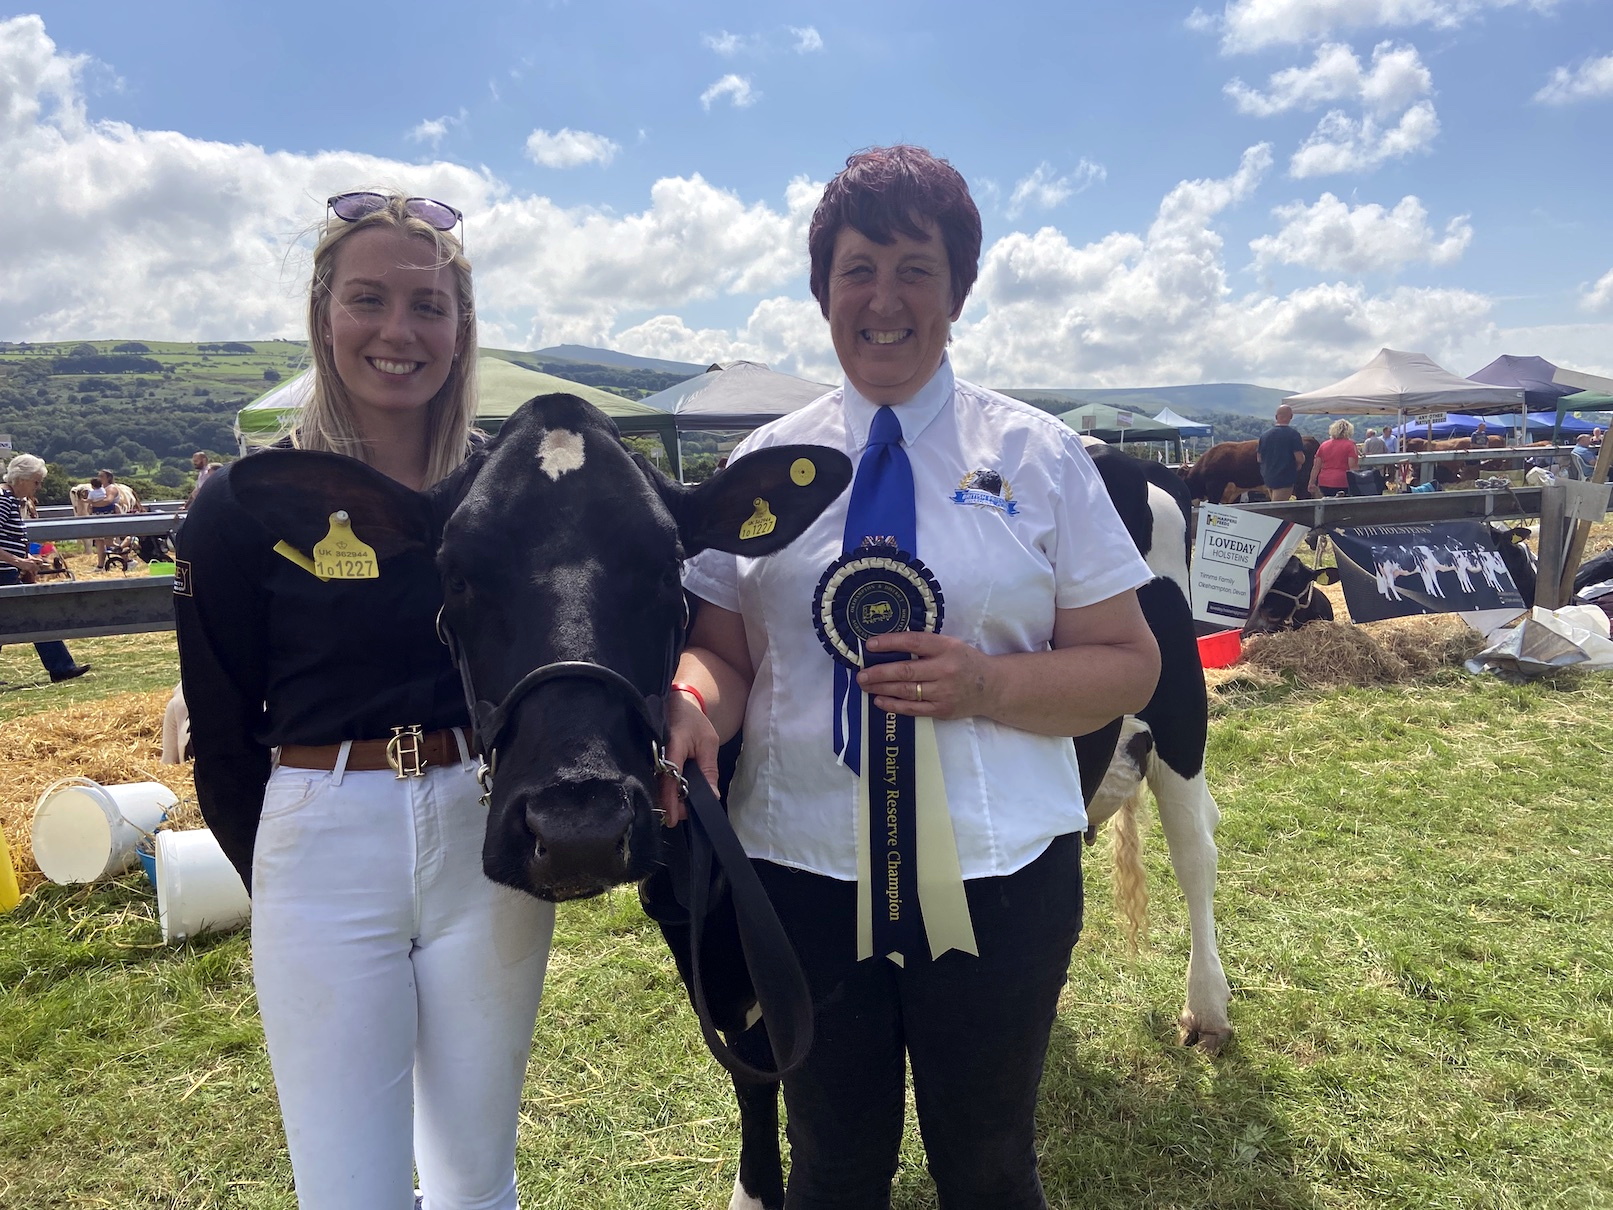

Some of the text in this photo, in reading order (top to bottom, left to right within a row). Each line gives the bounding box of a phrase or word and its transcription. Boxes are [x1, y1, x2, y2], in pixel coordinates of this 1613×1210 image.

[1209, 536, 1256, 554] LOVEDAY
[1213, 550, 1249, 563] HOLSTEINS
[1200, 572, 1235, 586] Timms Family
[1232, 588, 1247, 596] Devon
[883, 712, 903, 921] eme Dairy Reserve Champion
